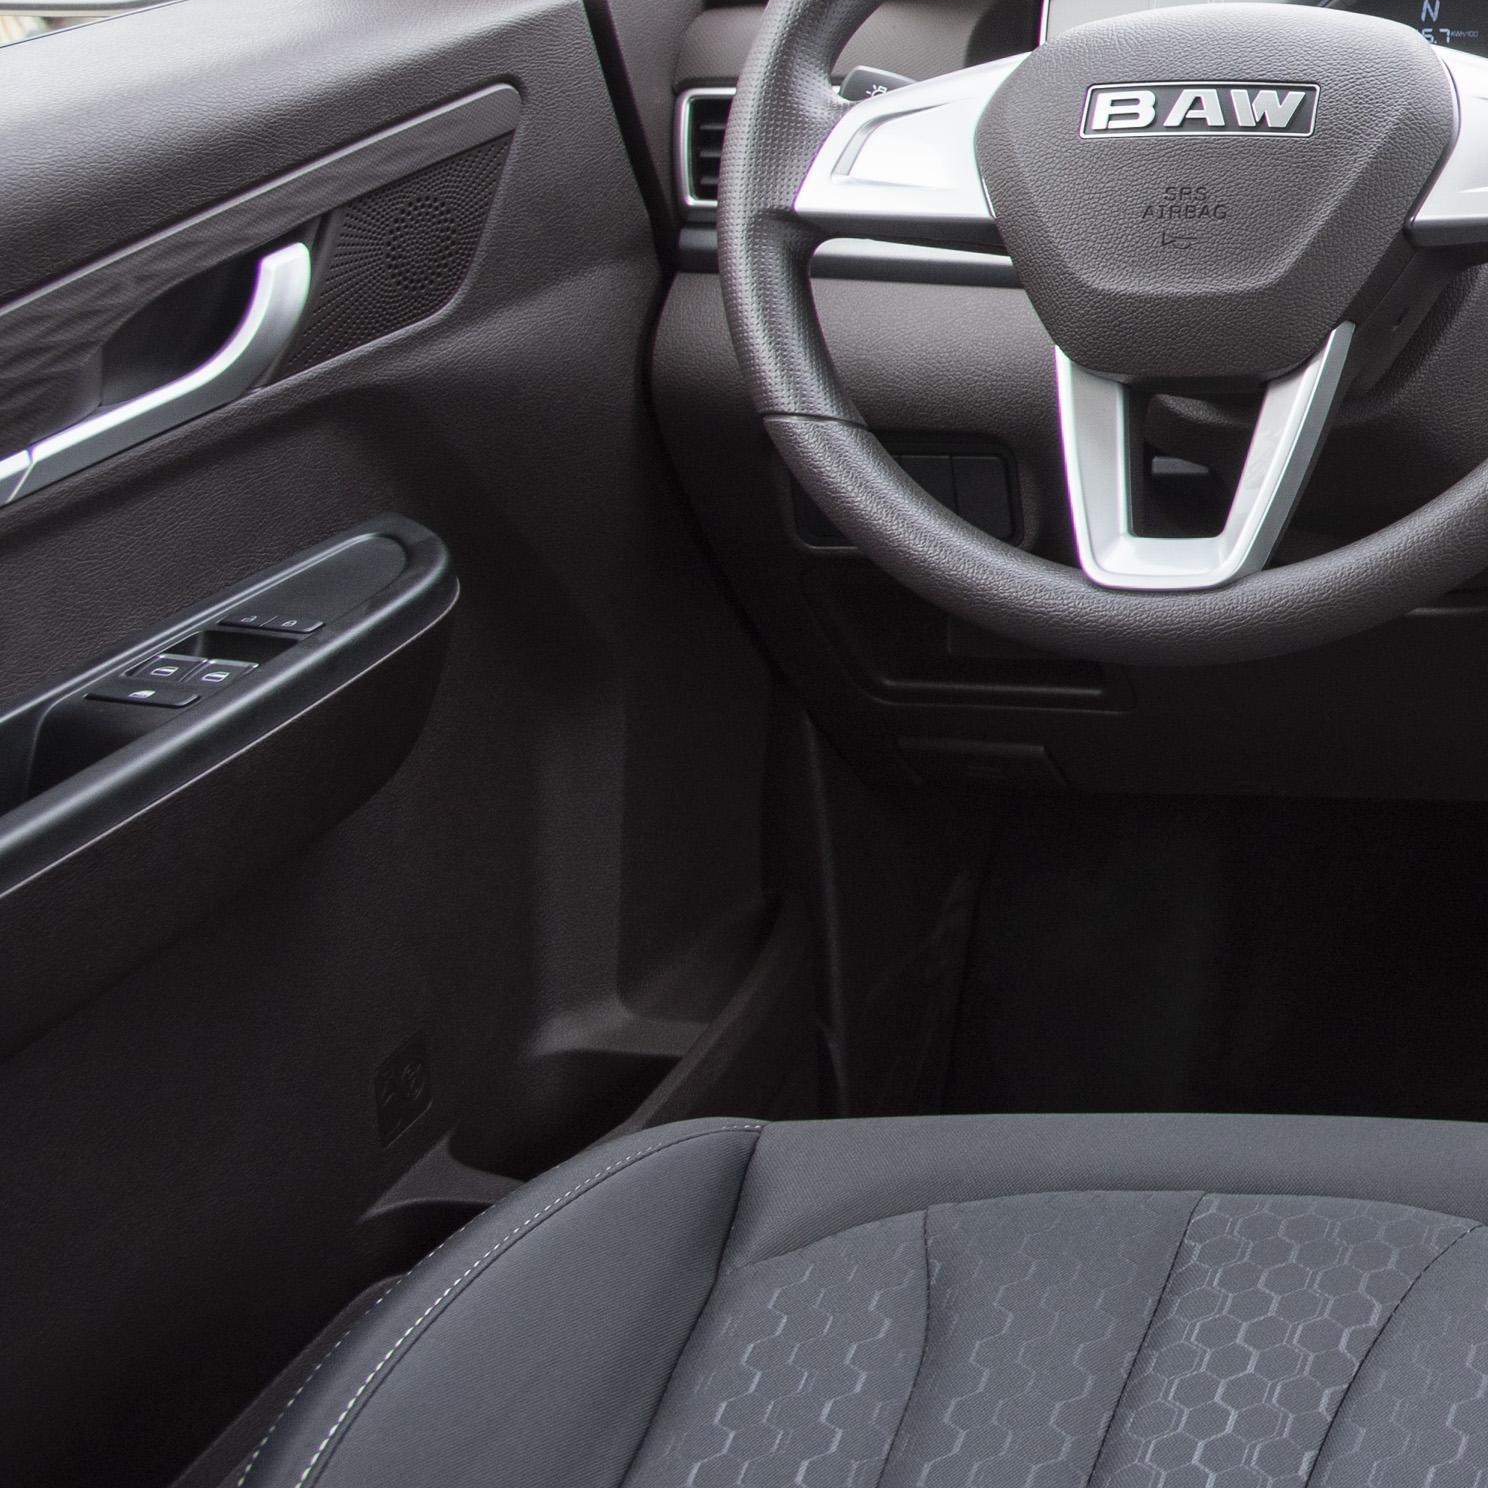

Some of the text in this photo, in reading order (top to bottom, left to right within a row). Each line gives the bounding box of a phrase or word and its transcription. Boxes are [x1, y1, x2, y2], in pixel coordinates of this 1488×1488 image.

[1421, 0, 1441, 22] N
[1091, 89, 1307, 130] BAW
[1163, 186, 1207, 201] SRS
[1141, 204, 1228, 220] AIRBAG
